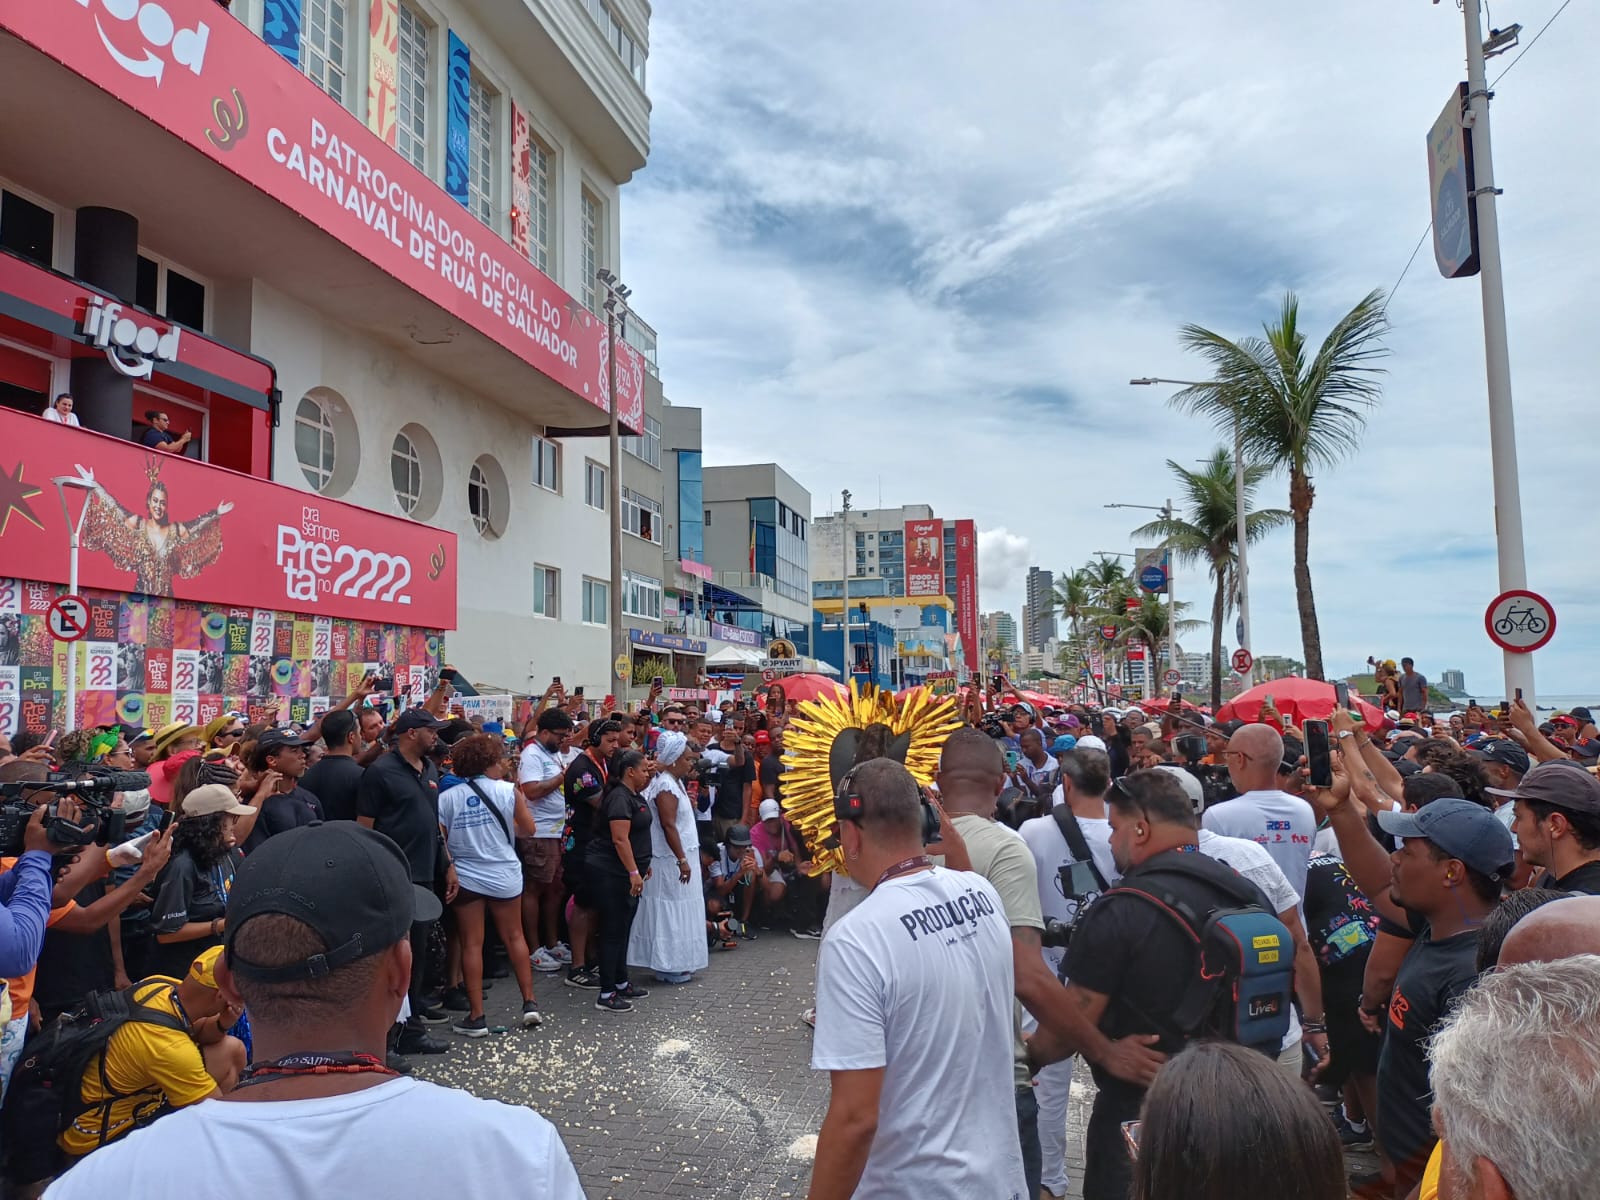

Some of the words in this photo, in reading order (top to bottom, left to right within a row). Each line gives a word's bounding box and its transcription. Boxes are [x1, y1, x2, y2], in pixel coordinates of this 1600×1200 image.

[266, 128, 402, 248] CARNAVAL
[410, 230, 436, 270] DE
[441, 252, 477, 299] RUA
[482, 282, 503, 317] DE
[507, 301, 577, 368] SALVADOR
[311, 117, 475, 268] PATROCINADOR
[480, 252, 538, 314] OFICIAL
[542, 298, 560, 329] DO
[87, 295, 180, 362] ifood
[302, 506, 320, 523] pra
[302, 522, 340, 543] sempre
[318, 578, 332, 592] no
[332, 545, 412, 604] 2222
[900, 888, 994, 941] PRODUÇÃO
